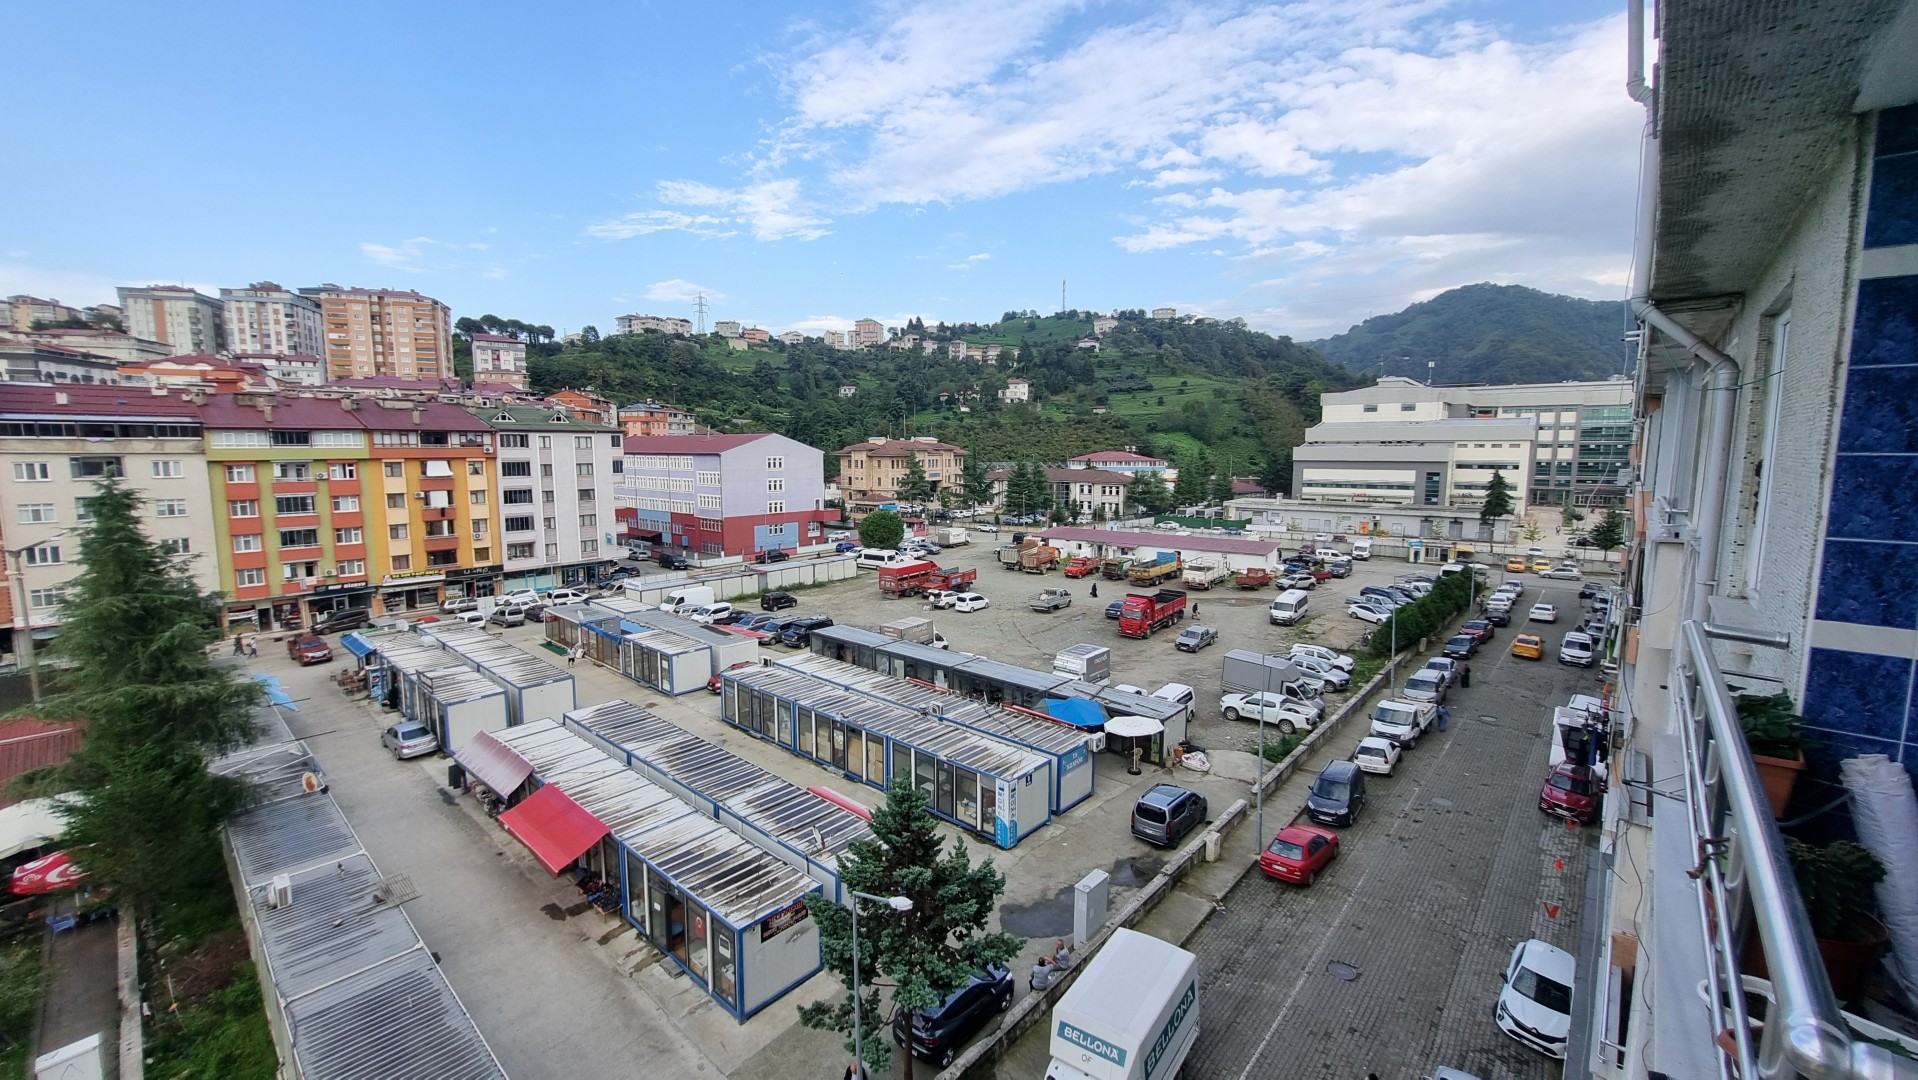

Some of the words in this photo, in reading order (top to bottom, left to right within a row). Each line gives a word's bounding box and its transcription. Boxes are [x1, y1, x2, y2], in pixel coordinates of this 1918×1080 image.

[1064, 1025, 1119, 1062] BELLONA
[1146, 989, 1194, 1072] BELLONA
[1081, 1053, 1092, 1064] OF
